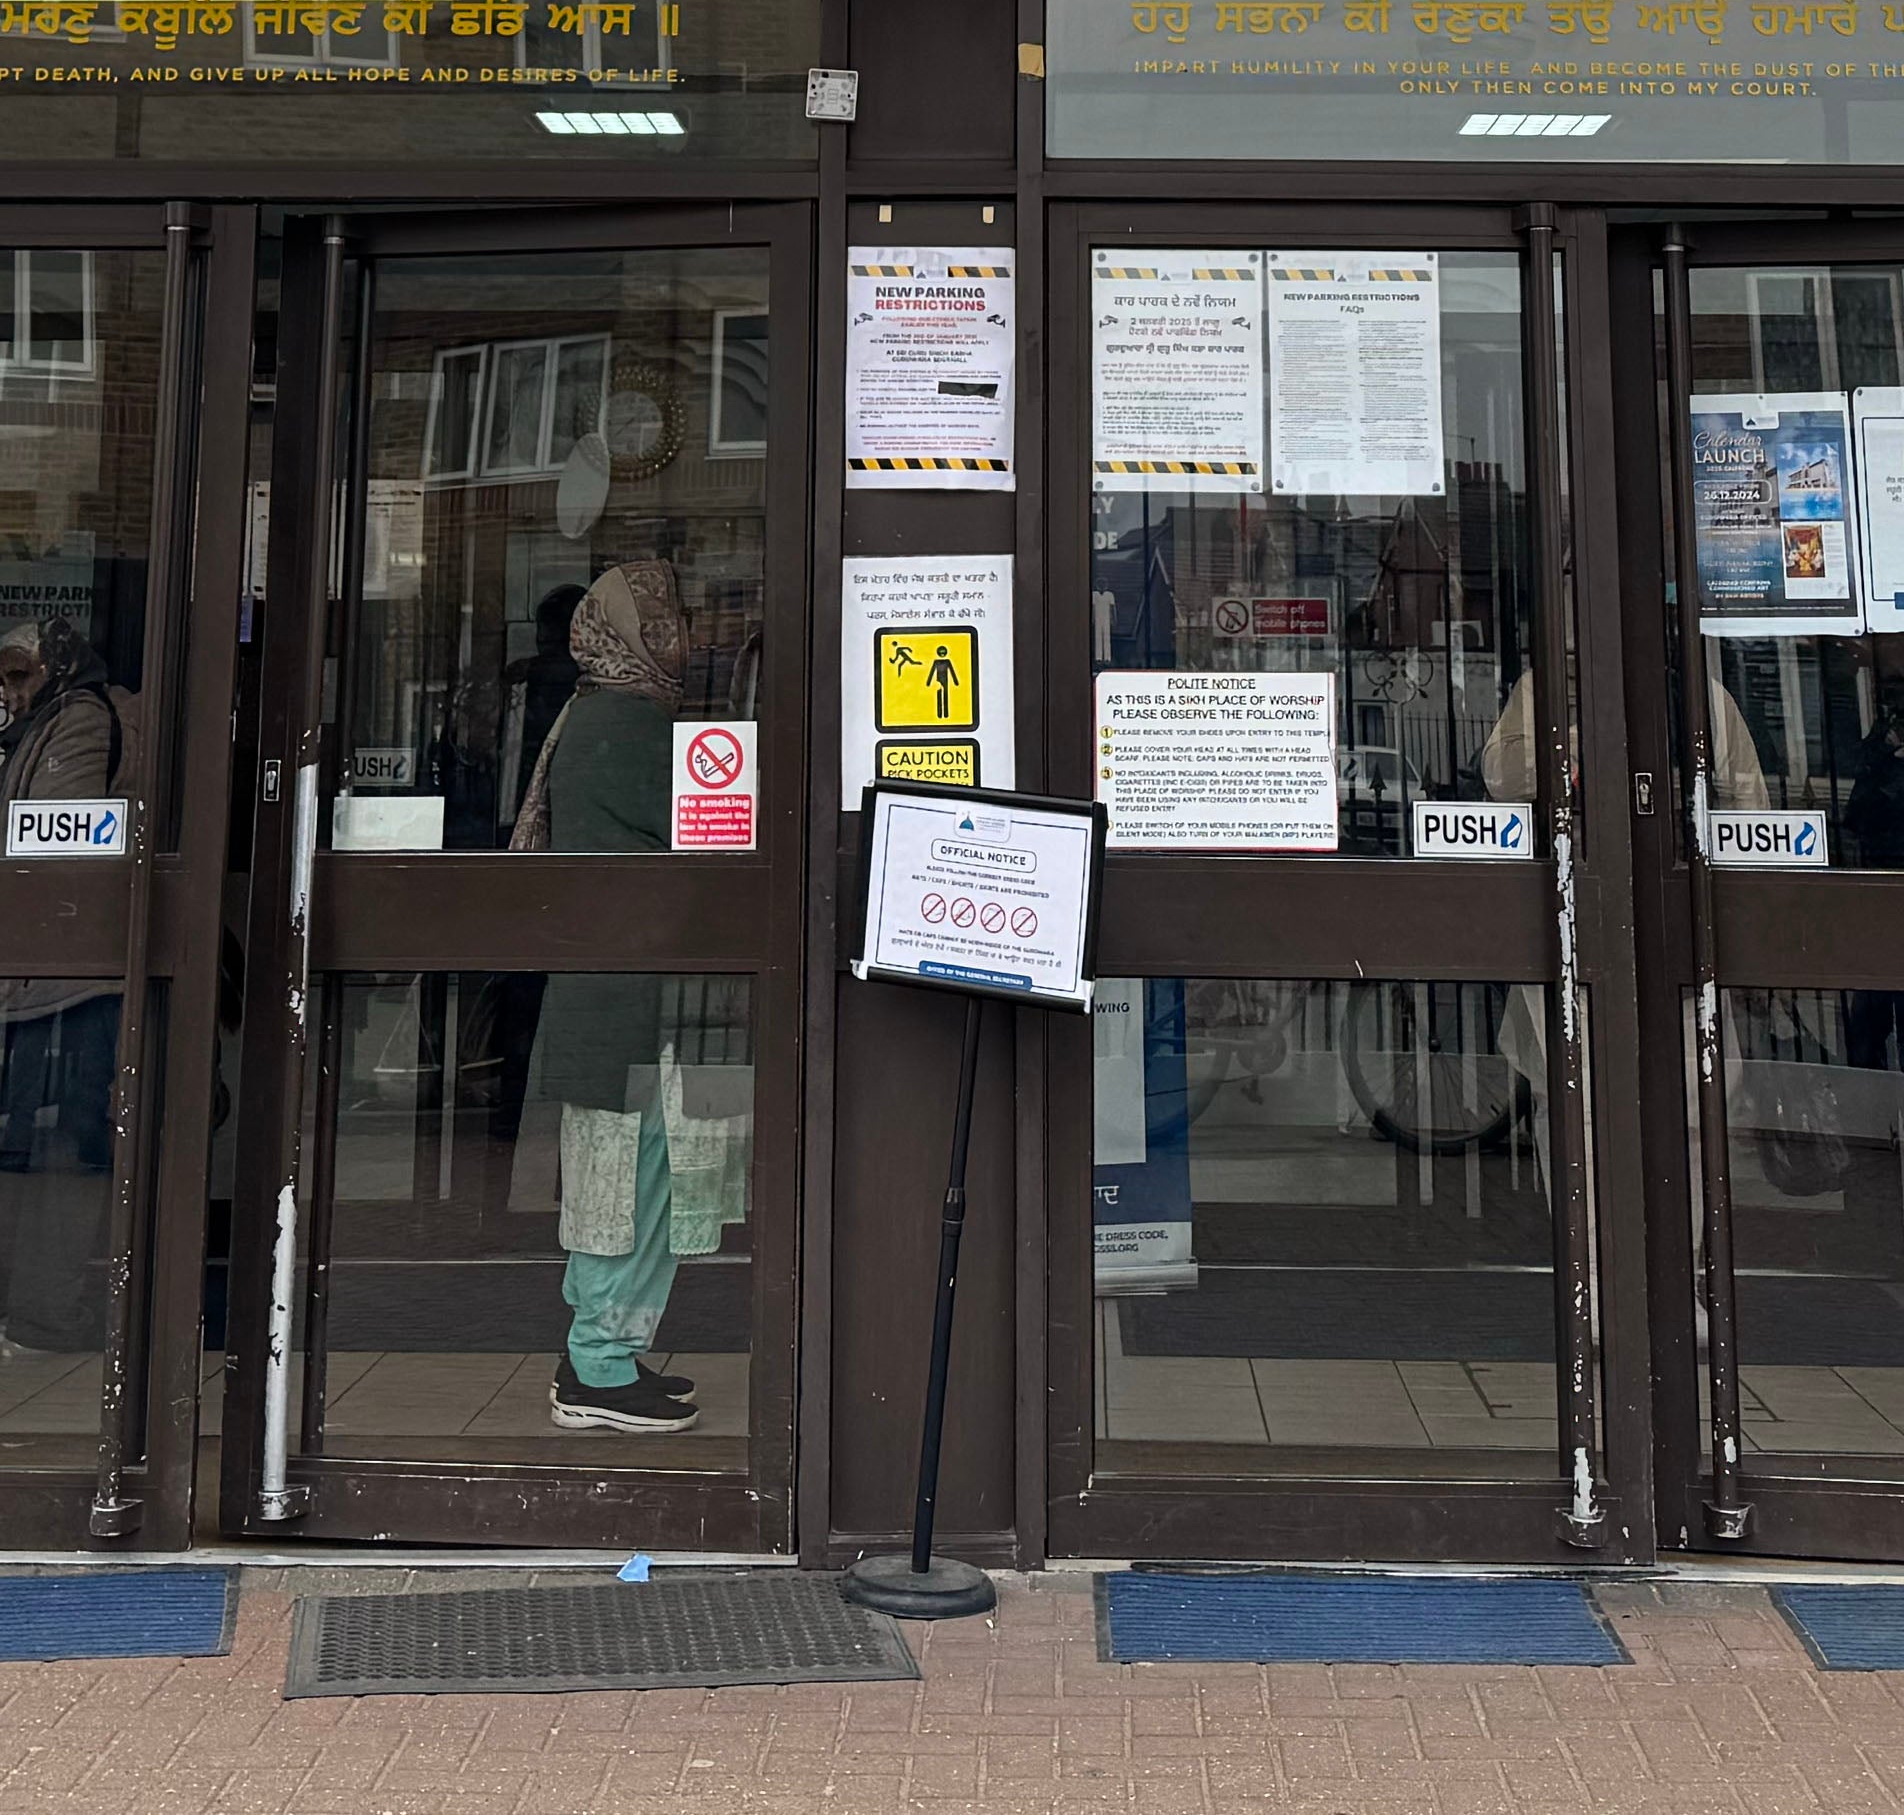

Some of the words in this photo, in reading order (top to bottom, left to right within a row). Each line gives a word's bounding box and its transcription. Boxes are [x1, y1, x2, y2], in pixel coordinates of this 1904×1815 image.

[35, 67, 119, 83] DEATH,
[130, 67, 179, 82] AND
[189, 67, 244, 82] GIVE
[254, 67, 284, 82] UP
[295, 67, 338, 82] ALL
[348, 67, 410, 82] HOPE
[420, 67, 470, 82] AND
[480, 67, 578, 82] DESIRES
[587, 67, 619, 82] OF
[629, 67, 686, 82] LIFE.
[1134, 60, 1221, 75] IMPART
[1231, 60, 1342, 75] HUMILITY
[1353, 60, 1377, 75] IN
[1387, 60, 1451, 75] YOUR
[1461, 61, 1511, 75] LIFE
[1530, 61, 1580, 75] AND
[1589, 61, 1688, 76] BECOME
[1699, 62, 1742, 78] THE
[1754, 62, 1814, 78] DUST
[1825, 62, 1857, 78] OF
[1399, 80, 1462, 96] ONLY
[1472, 80, 1533, 96] THEN
[1543, 80, 1609, 96] COME
[1619, 80, 1676, 96] INTO
[1687, 80, 1717, 96] MY
[1730, 80, 1818, 96] COURT.
[875, 286, 914, 299] NEW
[915, 286, 986, 299] PARKING
[875, 299, 986, 312] RESTRICTIONS
[1694, 448, 1765, 464] LAUNCH
[1167, 678, 1208, 690] POLITE
[1212, 678, 1256, 690] NOTICE
[1106, 695, 1122, 705] AS
[1125, 695, 1151, 705] THIS
[1155, 695, 1166, 705] IS
[1168, 695, 1176, 705] A
[1208, 695, 1247, 705] PLACE
[1250, 695, 1267, 705] OF
[1269, 695, 1325, 705] WORSHIP
[1112, 709, 1157, 720] PLEASE
[1160, 709, 1217, 720] OBSERVE
[1220, 709, 1243, 720] THE
[1246, 709, 1319, 720] FOLLOWING:
[886, 750, 969, 767] CAUTION
[916, 768, 970, 780] POCKETS
[679, 797, 696, 808] No
[699, 796, 750, 810] smoking
[18, 812, 91, 843] PUSH
[1424, 814, 1498, 845] PUSH
[1717, 821, 1791, 853] PUSH
[940, 844, 985, 862] OFFICIAL
[987, 852, 1027, 866] NOTICE
